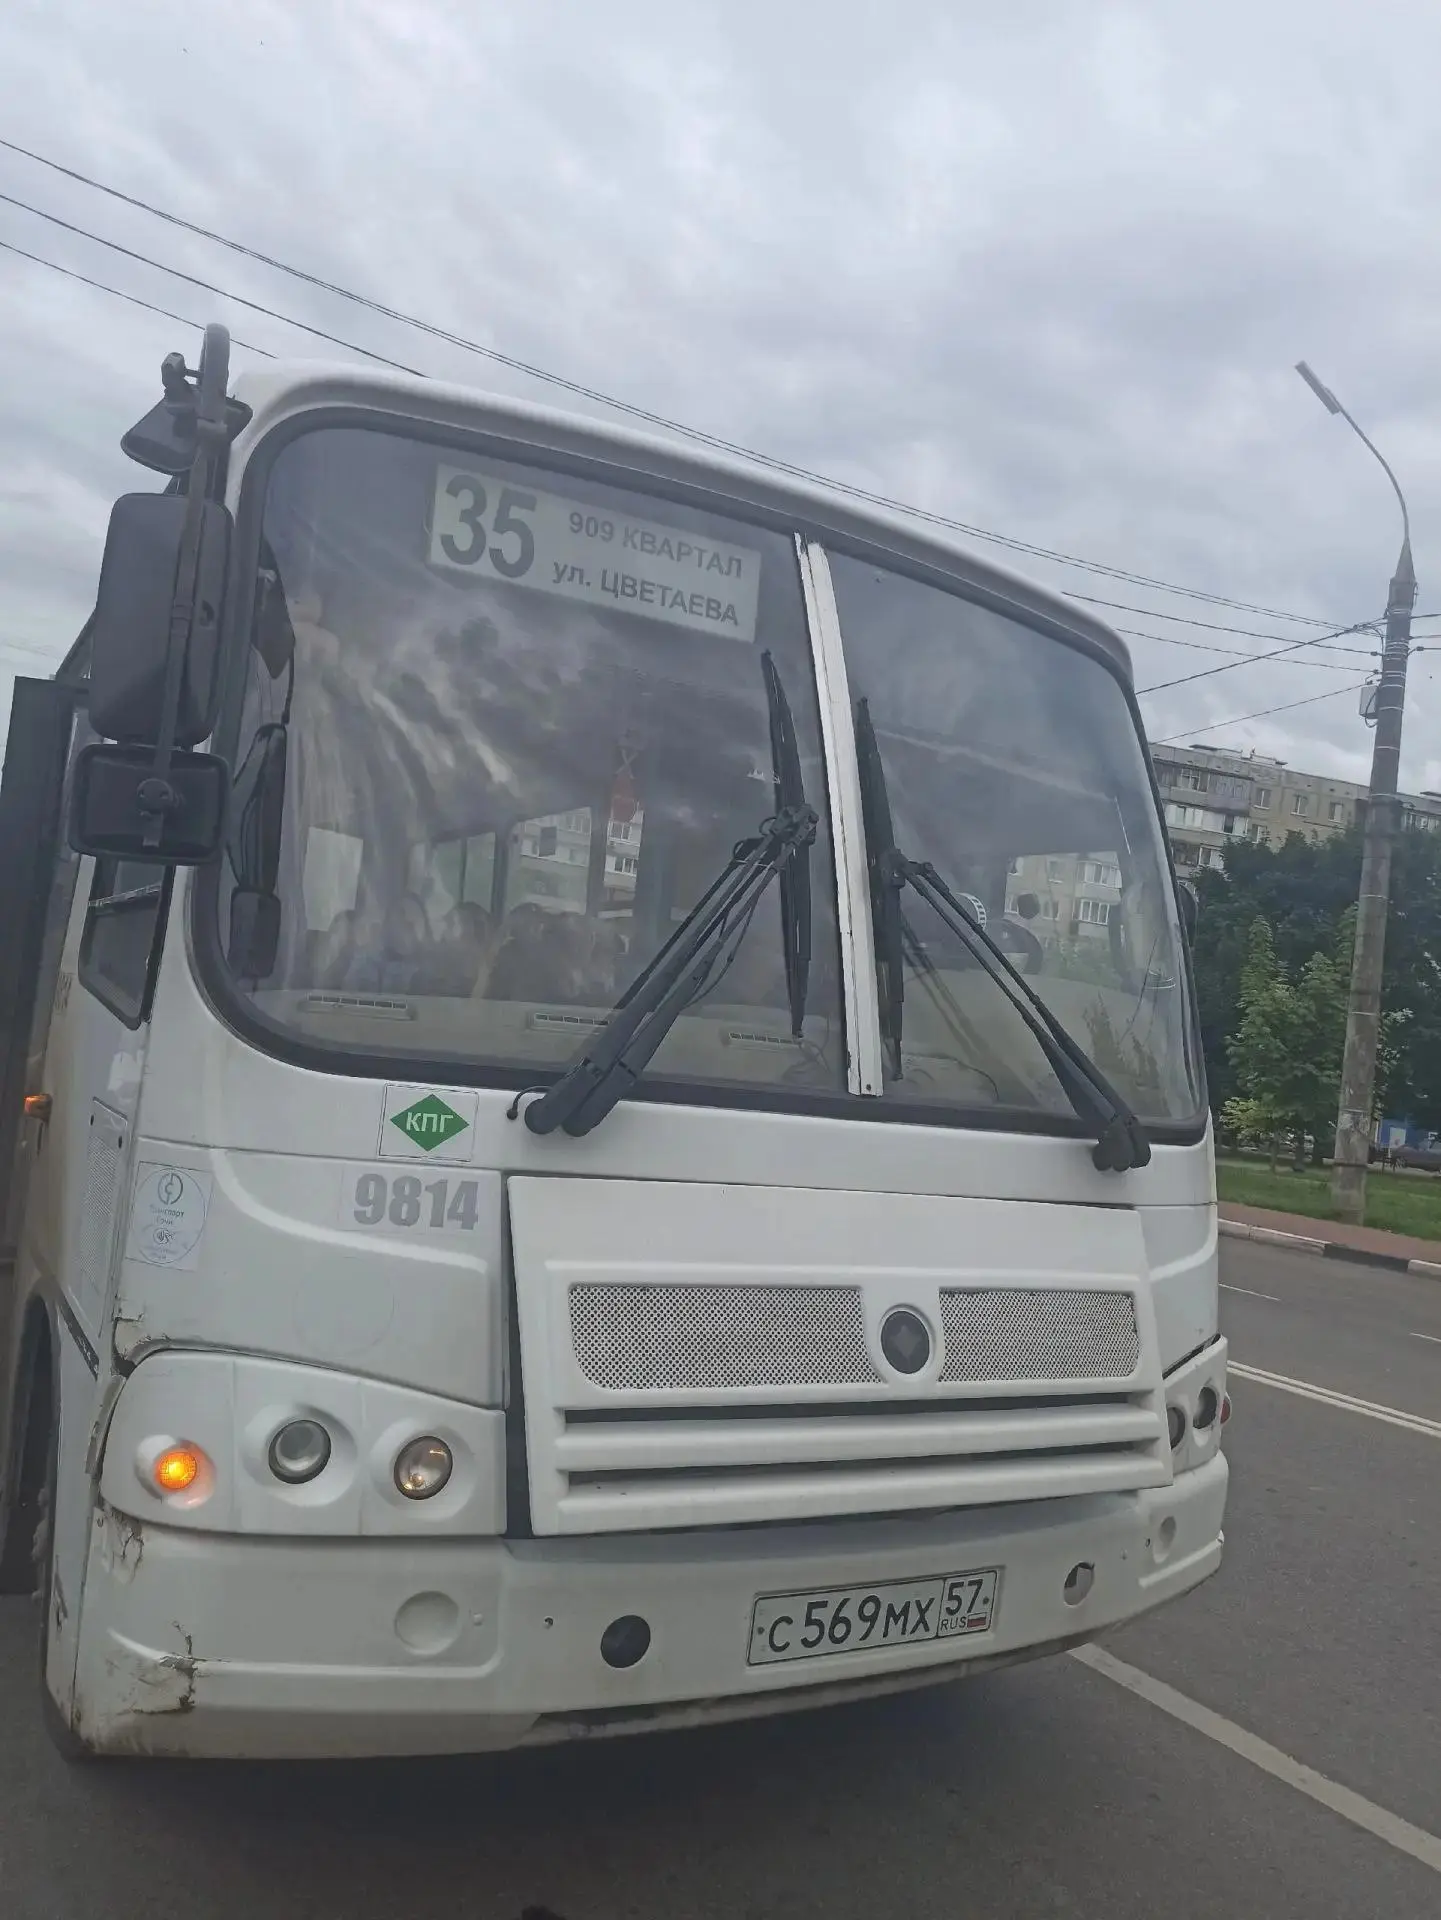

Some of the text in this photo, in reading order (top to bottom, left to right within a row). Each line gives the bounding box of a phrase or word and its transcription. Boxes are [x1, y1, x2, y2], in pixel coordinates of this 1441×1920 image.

[441, 474, 537, 578] 35
[569, 511, 742, 579] 909 КВАРТАЛ
[552, 562, 739, 626] ул. ЦВЕТАЕВА
[406, 1112, 454, 1133] КПГ
[354, 1173, 479, 1231] 9814
[940, 1616, 967, 1632] RUS
[945, 1579, 984, 1616] 57
